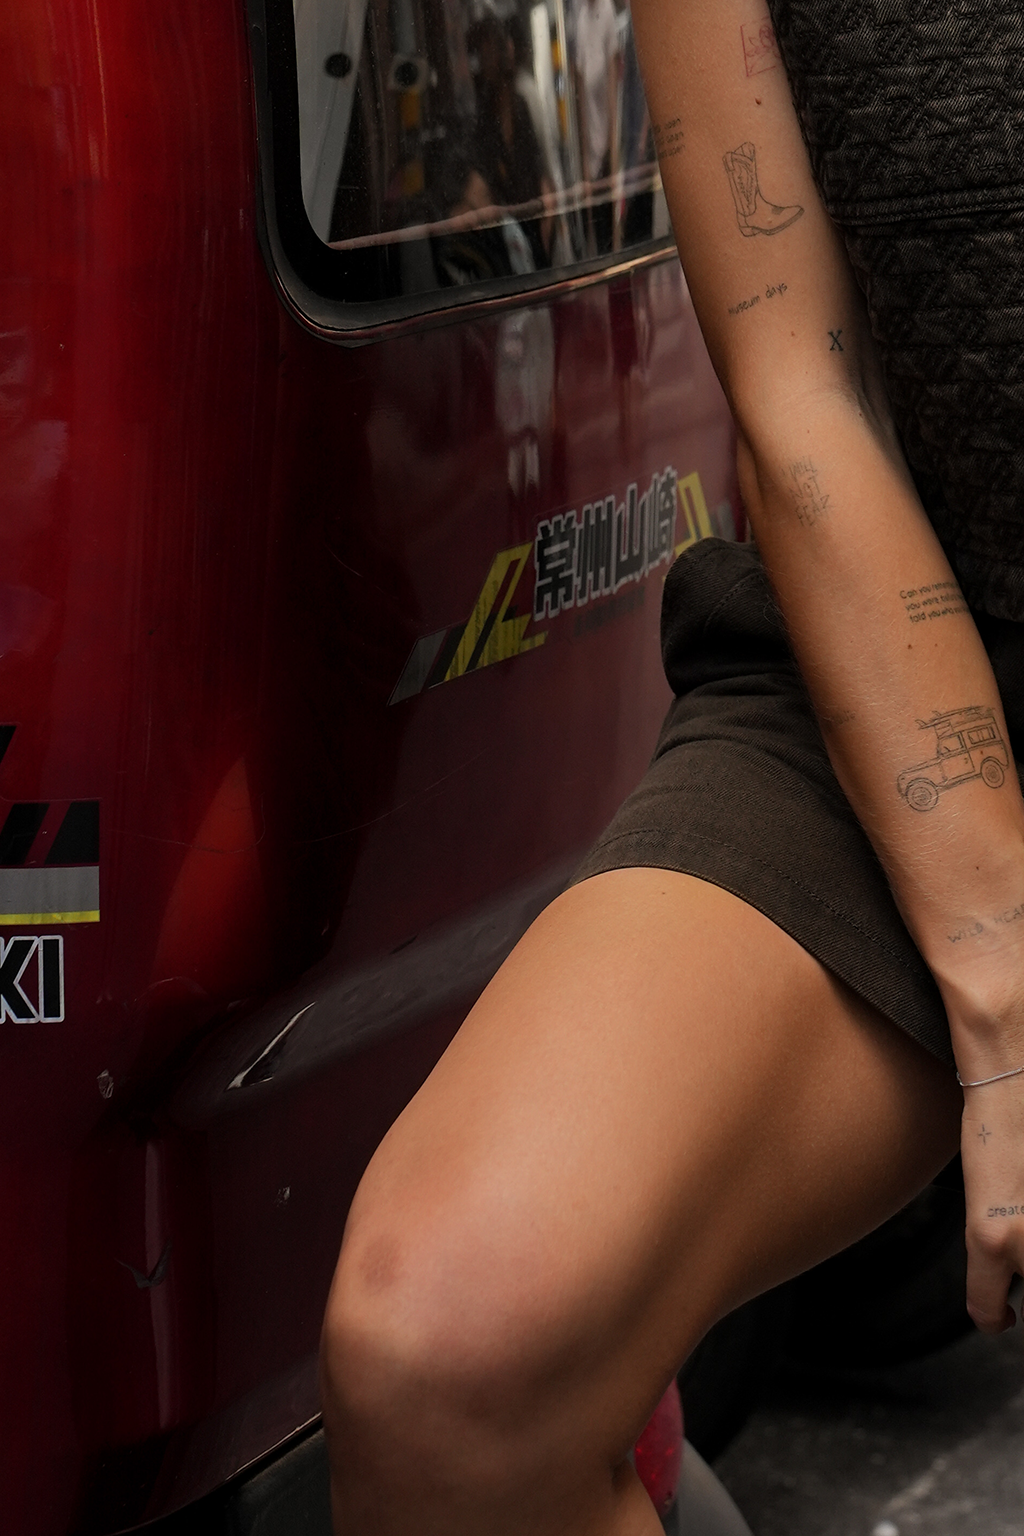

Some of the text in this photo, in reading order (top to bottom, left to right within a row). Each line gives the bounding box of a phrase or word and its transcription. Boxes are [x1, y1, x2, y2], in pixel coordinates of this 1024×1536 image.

[765, 282, 788, 300] days
[828, 330, 844, 352] X
[534, 465, 678, 622] 常州山崎
[899, 589, 918, 600] Can
[909, 610, 927, 623] told
